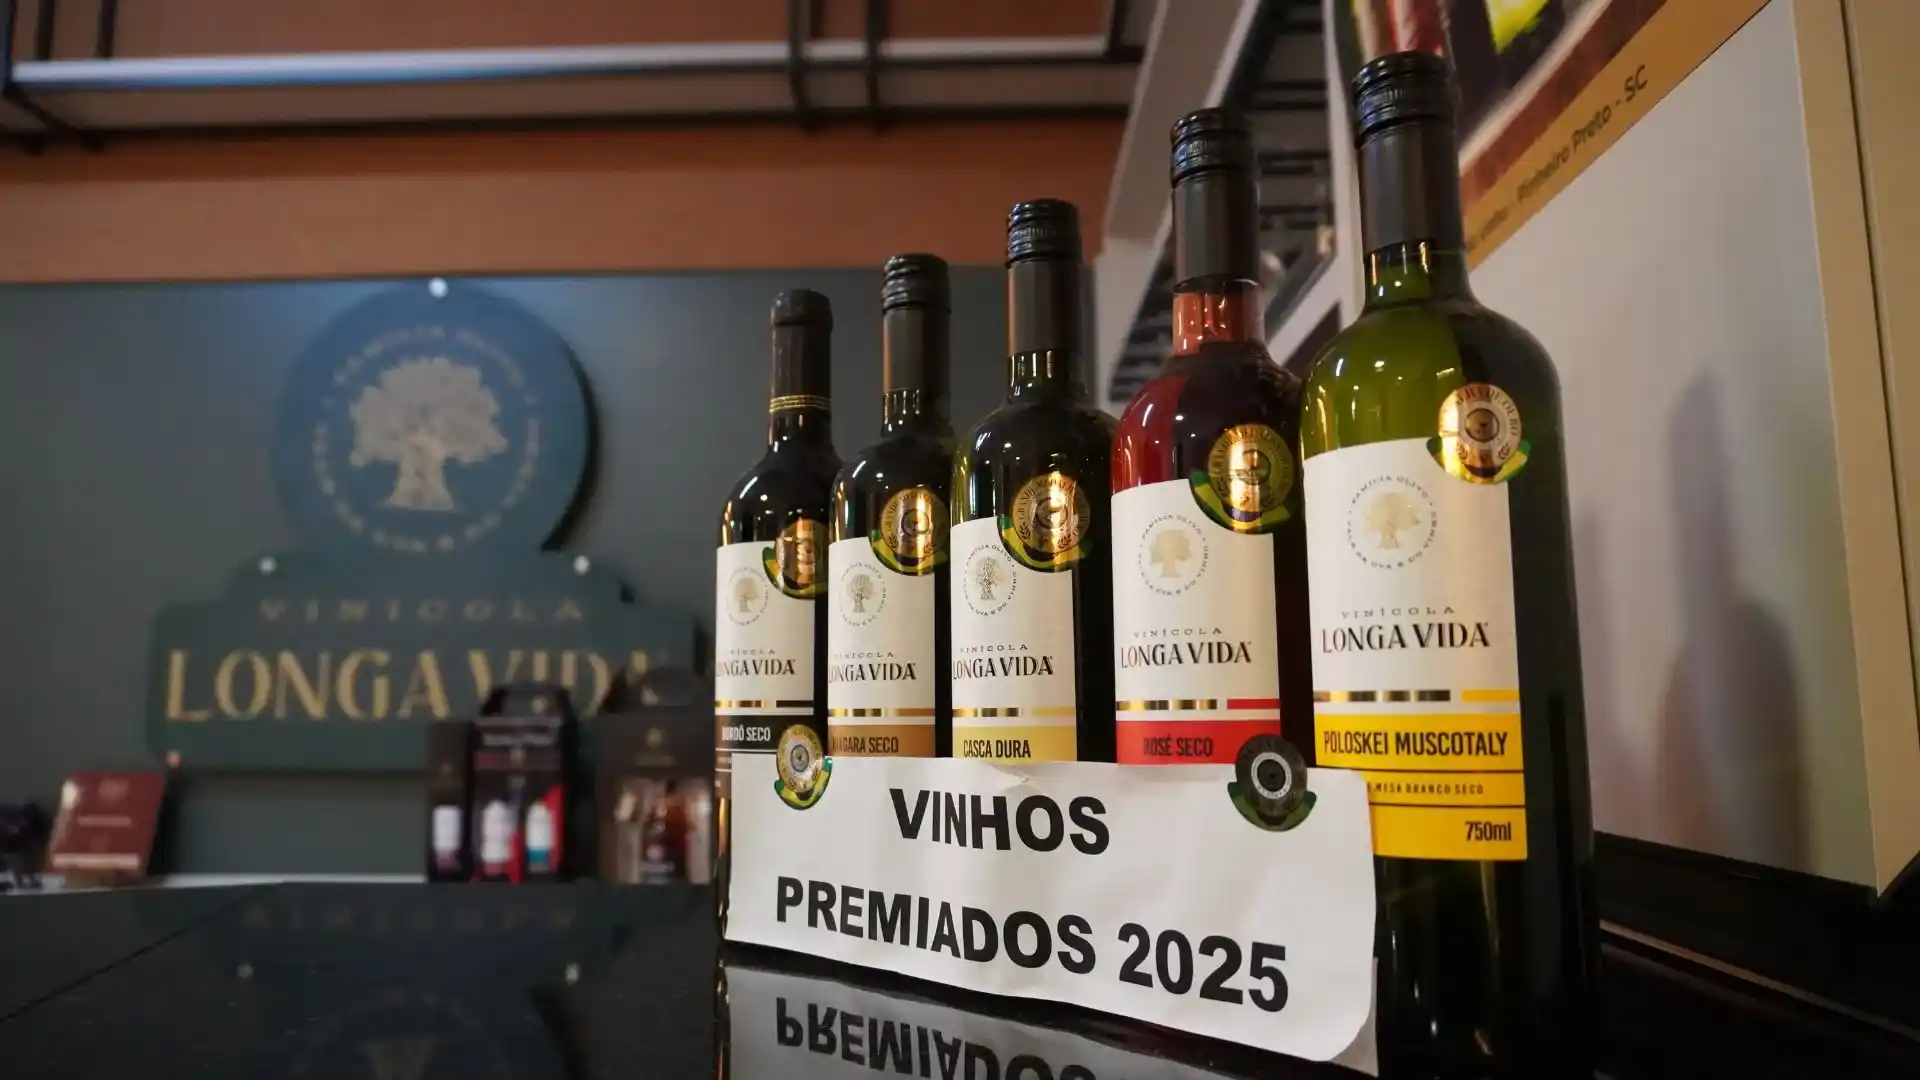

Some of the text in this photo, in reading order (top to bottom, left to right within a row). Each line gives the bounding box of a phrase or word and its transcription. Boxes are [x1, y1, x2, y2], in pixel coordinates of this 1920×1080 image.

[1571, 105, 1613, 152] Preto
[1624, 64, 1649, 102] SC
[1322, 621, 1491, 653] LONGA VIDA
[751, 658, 796, 677] VIDA
[953, 655, 1053, 680] LONGA VIDA
[1120, 641, 1252, 669] LONGA VIDA
[868, 661, 917, 681] VIDA
[166, 649, 450, 721] LONGA
[746, 726, 771, 741] SECO
[868, 736, 899, 753] SECO
[1144, 732, 1214, 758] ROSÉ SECO
[1324, 731, 1508, 756] POLOSKEI MUSCOTALY
[963, 739, 1031, 758] CASCA DURA
[1375, 782, 1402, 793] MESA
[1406, 783, 1451, 795] BRANCO
[1455, 783, 1484, 796] SECO
[890, 788, 1110, 856] VINHOS
[1465, 820, 1512, 841] 750ml
[776, 875, 1289, 1013] PREMIADOS 2025
